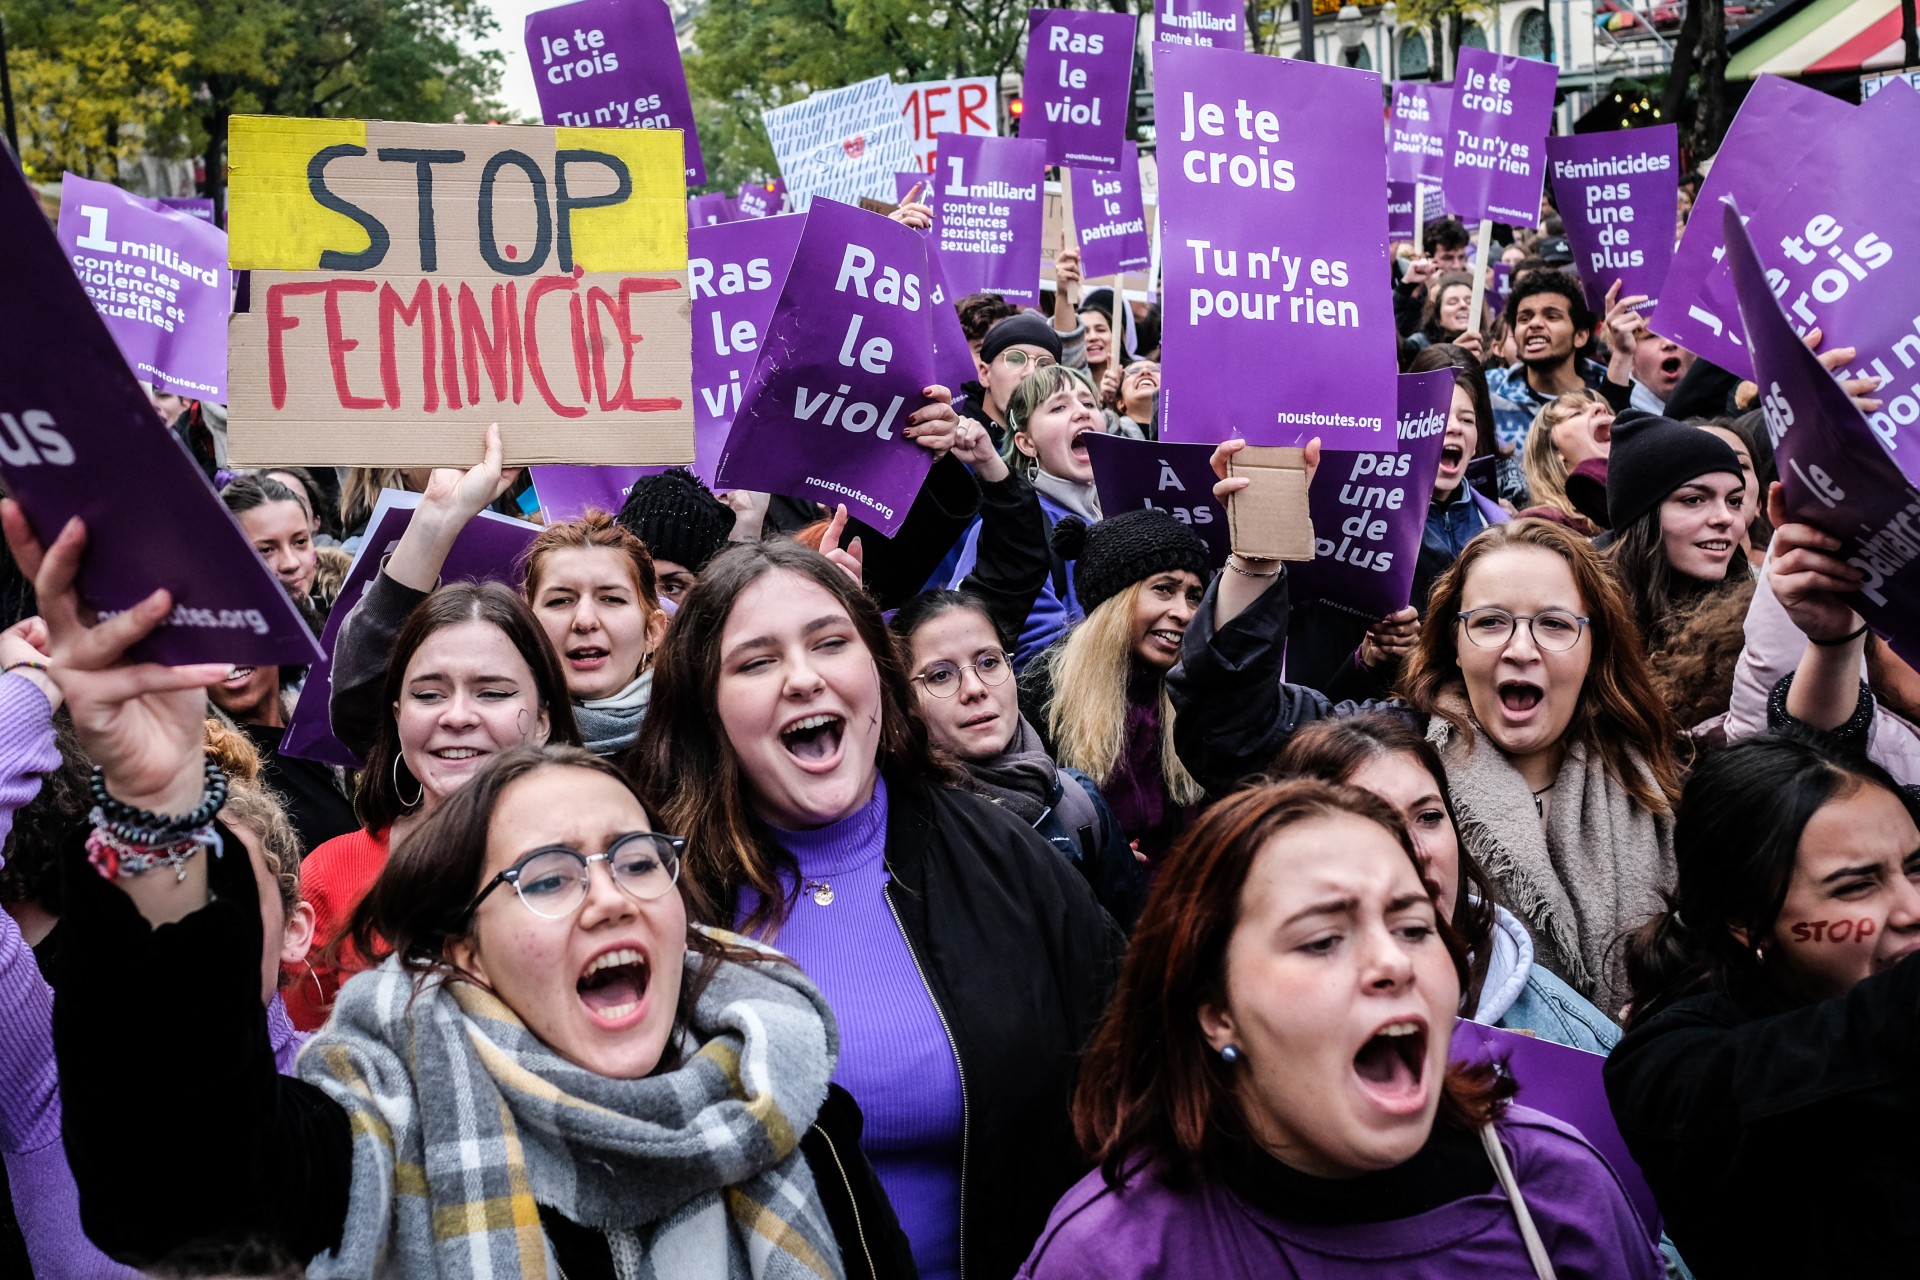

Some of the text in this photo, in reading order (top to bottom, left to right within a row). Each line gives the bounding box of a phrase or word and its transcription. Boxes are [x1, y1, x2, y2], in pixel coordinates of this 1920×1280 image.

[1178, 10, 1236, 32] milliard
[541, 28, 605, 64] Je te
[1049, 26, 1104, 55] Ras
[1160, 32, 1213, 47] contre les
[547, 50, 618, 84] crois
[1059, 60, 1088, 89] le
[1463, 67, 1511, 95] Je te
[557, 94, 661, 127] Tu n'y es
[1045, 98, 1102, 126] viol
[1396, 106, 1430, 121] crois
[1397, 92, 1427, 108] Je te
[1462, 92, 1513, 116] crois
[1180, 91, 1280, 143] Je te
[1393, 142, 1443, 157] pour rien
[1395, 129, 1410, 141] Tu
[1430, 136, 1443, 147] es
[1457, 130, 1529, 158] Tu n'y es
[1065, 152, 1115, 164] noustoutes.org
[1183, 146, 1296, 192] crois
[1454, 150, 1530, 176] pour rien
[1554, 152, 1671, 178] Féminicides
[945, 156, 969, 197] 1
[970, 181, 1037, 201] milliard
[1091, 179, 1122, 197] bas
[1103, 199, 1122, 216] le
[1586, 182, 1631, 207] pas
[307, 143, 633, 277] STOP
[942, 203, 1010, 216] contre les
[942, 213, 1008, 229] violences
[1586, 204, 1635, 224] une
[941, 226, 1014, 242] sexistes et
[1081, 217, 1144, 245] patriarcat
[1598, 223, 1630, 246] de
[1780, 214, 1844, 266] te
[76, 204, 219, 288] 1 milliard
[940, 239, 1007, 254] sexuelles
[1591, 246, 1644, 273] plus
[73, 255, 180, 290] contre les
[688, 257, 772, 300] Ras
[834, 243, 921, 312] Ras
[1186, 239, 1349, 292] Tu n'y es
[84, 286, 185, 323] existes et
[980, 287, 1033, 298] noustoutes.org
[95, 302, 174, 332] xuelles
[1190, 287, 1359, 328] pour rien
[266, 272, 683, 419] FEMINICIDE
[711, 311, 758, 356] le
[838, 314, 893, 374] le
[138, 362, 218, 394] noustoutes.org
[700, 370, 742, 418] vi
[793, 384, 905, 441] viol
[1277, 411, 1382, 432] noustoutes.org
[1158, 459, 1186, 491] À
[1349, 452, 1411, 482] pas
[805, 474, 894, 520] noustoutes.org
[1338, 483, 1405, 510] une
[1789, 458, 1846, 509] le
[1341, 509, 1388, 541] de
[1315, 536, 1394, 572] plus
[1791, 917, 1876, 943] STOP
